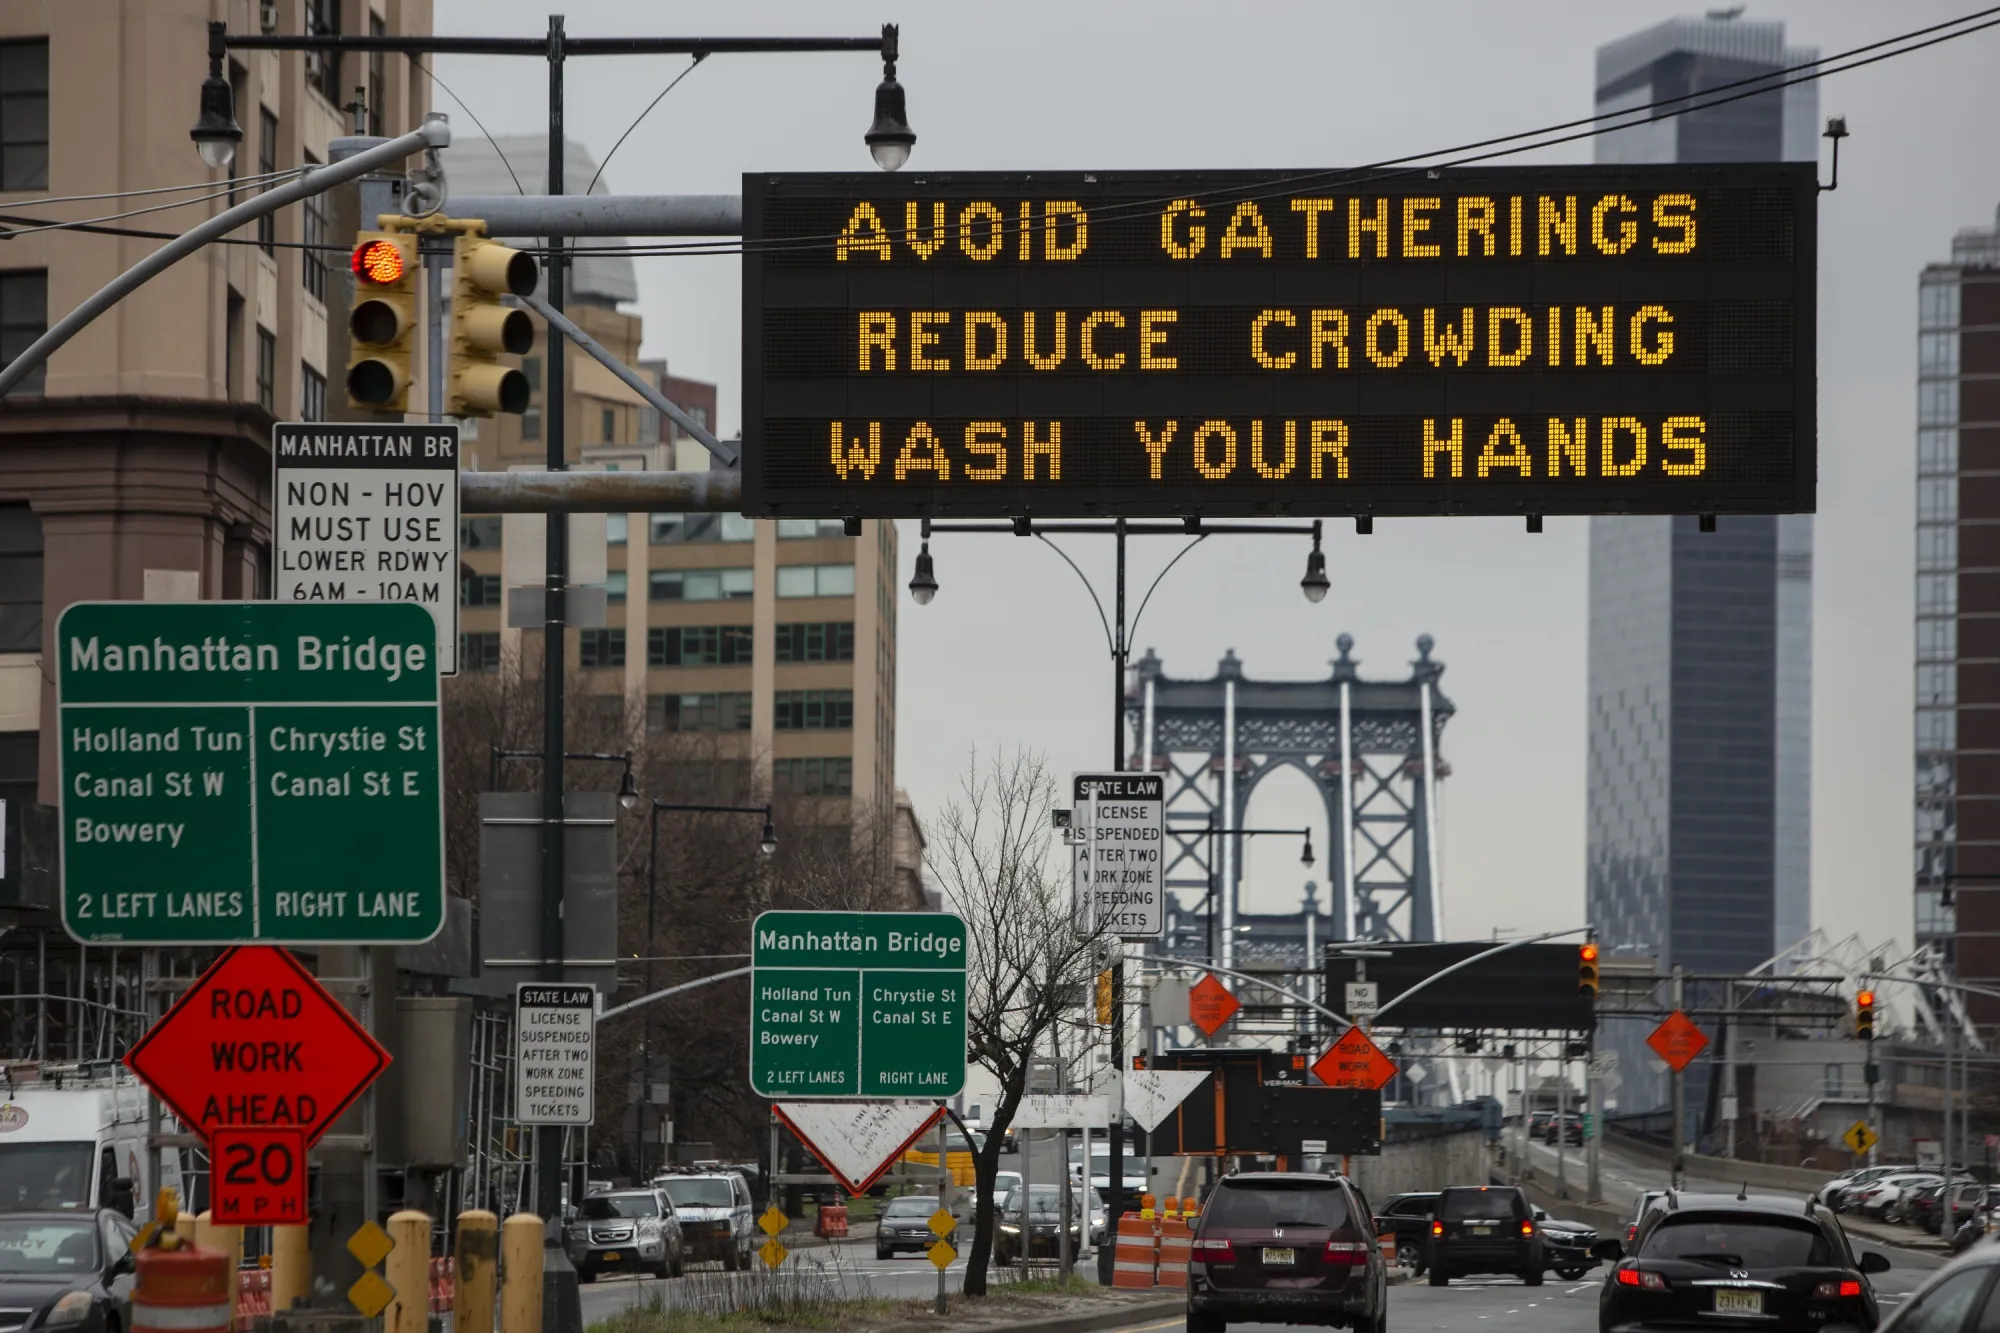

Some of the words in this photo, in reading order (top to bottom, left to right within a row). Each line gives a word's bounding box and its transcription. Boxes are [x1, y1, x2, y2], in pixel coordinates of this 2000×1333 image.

[836, 201, 1087, 261] AVOID
[1161, 194, 1696, 259] GATHERINGS
[859, 310, 1177, 370] REDUCE
[1252, 305, 1674, 369] CROWDING
[280, 435, 412, 457] MANHATTAN
[424, 436, 453, 457] BR
[830, 420, 1062, 481] WASH
[1134, 419, 1350, 480] YOUR
[1422, 415, 1706, 478] HANDS
[288, 482, 349, 506] NON
[385, 483, 445, 507] HOV
[291, 517, 370, 542] MUST
[384, 517, 442, 542] USE
[282, 550, 365, 571] LOWER
[378, 551, 449, 572] RDWY
[293, 582, 345, 600] 6AM
[378, 582, 439, 602] 10AM
[70, 636, 279, 672] Manhattan
[298, 636, 426, 682] Bridge
[72, 727, 179, 752] Holland
[190, 727, 242, 752] Tun
[269, 726, 386, 757] Chrystie
[398, 726, 427, 752] St
[74, 772, 152, 798] Canal
[164, 773, 193, 797] St
[203, 772, 224, 796] W
[270, 771, 349, 797] Canal
[363, 772, 390, 796] St
[403, 771, 420, 796] E
[1080, 781, 1122, 795] SATE
[1127, 782, 1157, 795] LAW
[1090, 806, 1148, 819] ICENSE
[75, 817, 185, 848] Bowery
[1078, 828, 1159, 841] SSPENDED
[1079, 849, 1123, 862] ATER
[1130, 849, 1157, 862] TWO
[1122, 871, 1152, 883] ZONE
[77, 893, 93, 919] 2
[102, 892, 157, 919] LEFT
[167, 892, 243, 917] LANES
[275, 892, 347, 917] RIGHT
[357, 892, 421, 917] LANE
[1092, 914, 1147, 925] ICKETS
[759, 930, 878, 951] Manhattan
[888, 932, 961, 958] Bridge
[524, 991, 559, 1004] STATE
[563, 992, 589, 1004] LAW
[761, 987, 818, 1001] Holland
[824, 988, 851, 1001] Tun
[873, 988, 935, 1005] Chrystie
[941, 989, 956, 1002] St
[1354, 988, 1368, 997] NO
[210, 989, 302, 1020] ROAD
[1348, 1001, 1375, 1009] TURNS
[531, 1013, 580, 1025] LICENSE
[761, 1009, 802, 1023] Canal
[809, 1010, 824, 1023] St
[830, 1010, 841, 1023] W
[873, 1010, 915, 1024] Canal
[921, 1011, 936, 1025] St
[943, 1012, 951, 1024] E
[521, 1031, 590, 1043] SUSPENDED
[761, 1031, 819, 1048] Bowery
[211, 1042, 303, 1072] WORK
[522, 1050, 560, 1061] AFTER
[564, 1050, 588, 1062] TWO
[1340, 1044, 1370, 1054] ROAD
[526, 1068, 554, 1080] WORK
[557, 1068, 584, 1080] ZONE
[1339, 1062, 1370, 1071] WORK
[767, 1071, 774, 1083] 2
[778, 1071, 804, 1083] LEFT
[809, 1072, 845, 1083] LANES
[879, 1072, 913, 1084] RIGHT
[918, 1072, 948, 1084] LANE
[525, 1086, 584, 1098] SPEEDING
[201, 1095, 317, 1125] AHEAD
[530, 1104, 579, 1116] TICKETS
[224, 1143, 293, 1185] 20
